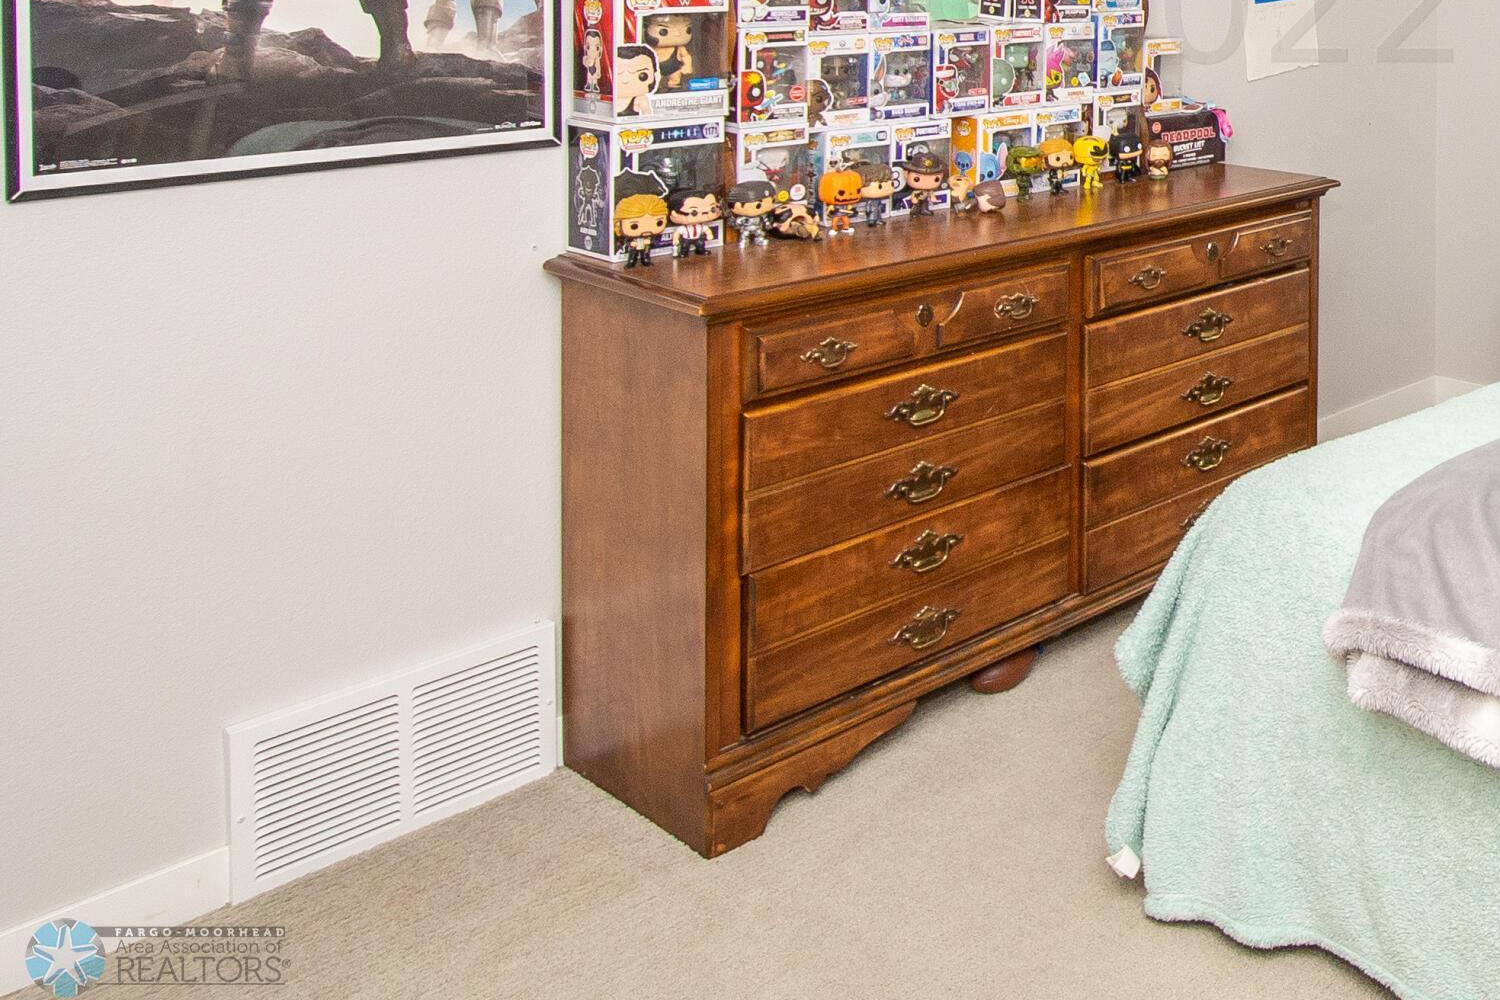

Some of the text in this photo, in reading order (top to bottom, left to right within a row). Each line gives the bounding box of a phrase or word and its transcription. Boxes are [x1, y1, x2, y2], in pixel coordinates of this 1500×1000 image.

[655, 95, 723, 108] ANDRE THE GIANT
[1161, 126, 1216, 144] DEADPOOL
[1173, 140, 1206, 153] BUCKET LIST
